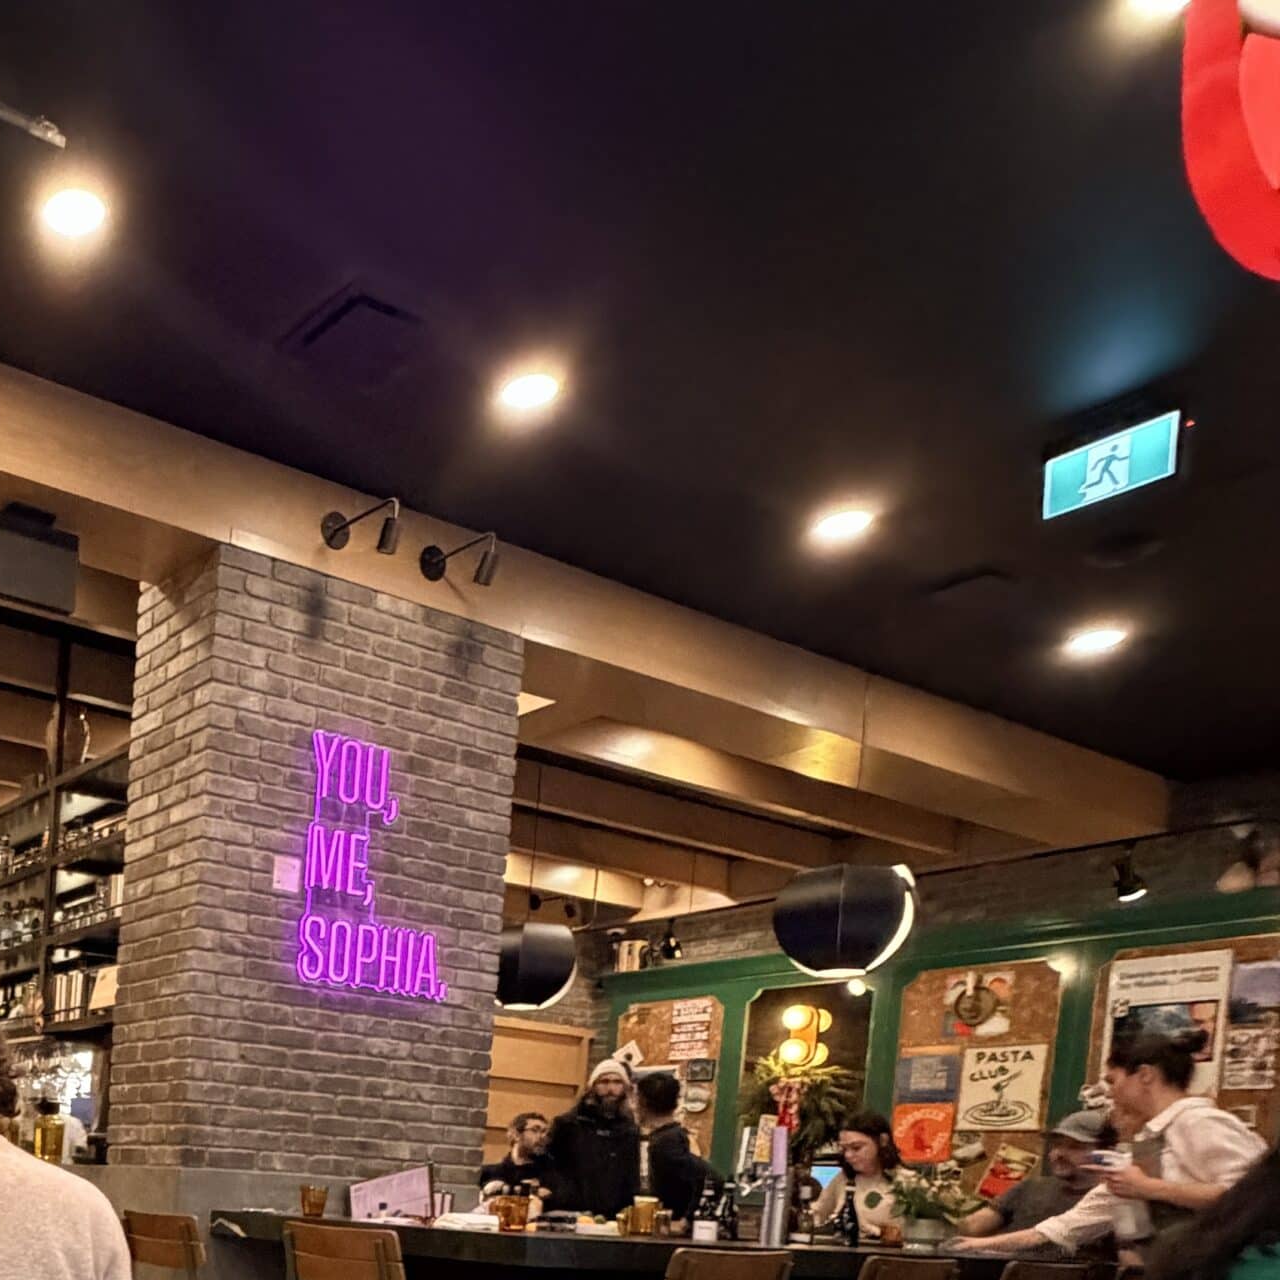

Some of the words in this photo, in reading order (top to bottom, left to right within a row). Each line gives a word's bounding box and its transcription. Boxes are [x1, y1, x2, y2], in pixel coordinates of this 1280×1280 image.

[314, 730, 398, 825] YOU,
[309, 826, 375, 905] ME,
[969, 1065, 1009, 1082] CLUB
[975, 1050, 1034, 1064] PASTA
